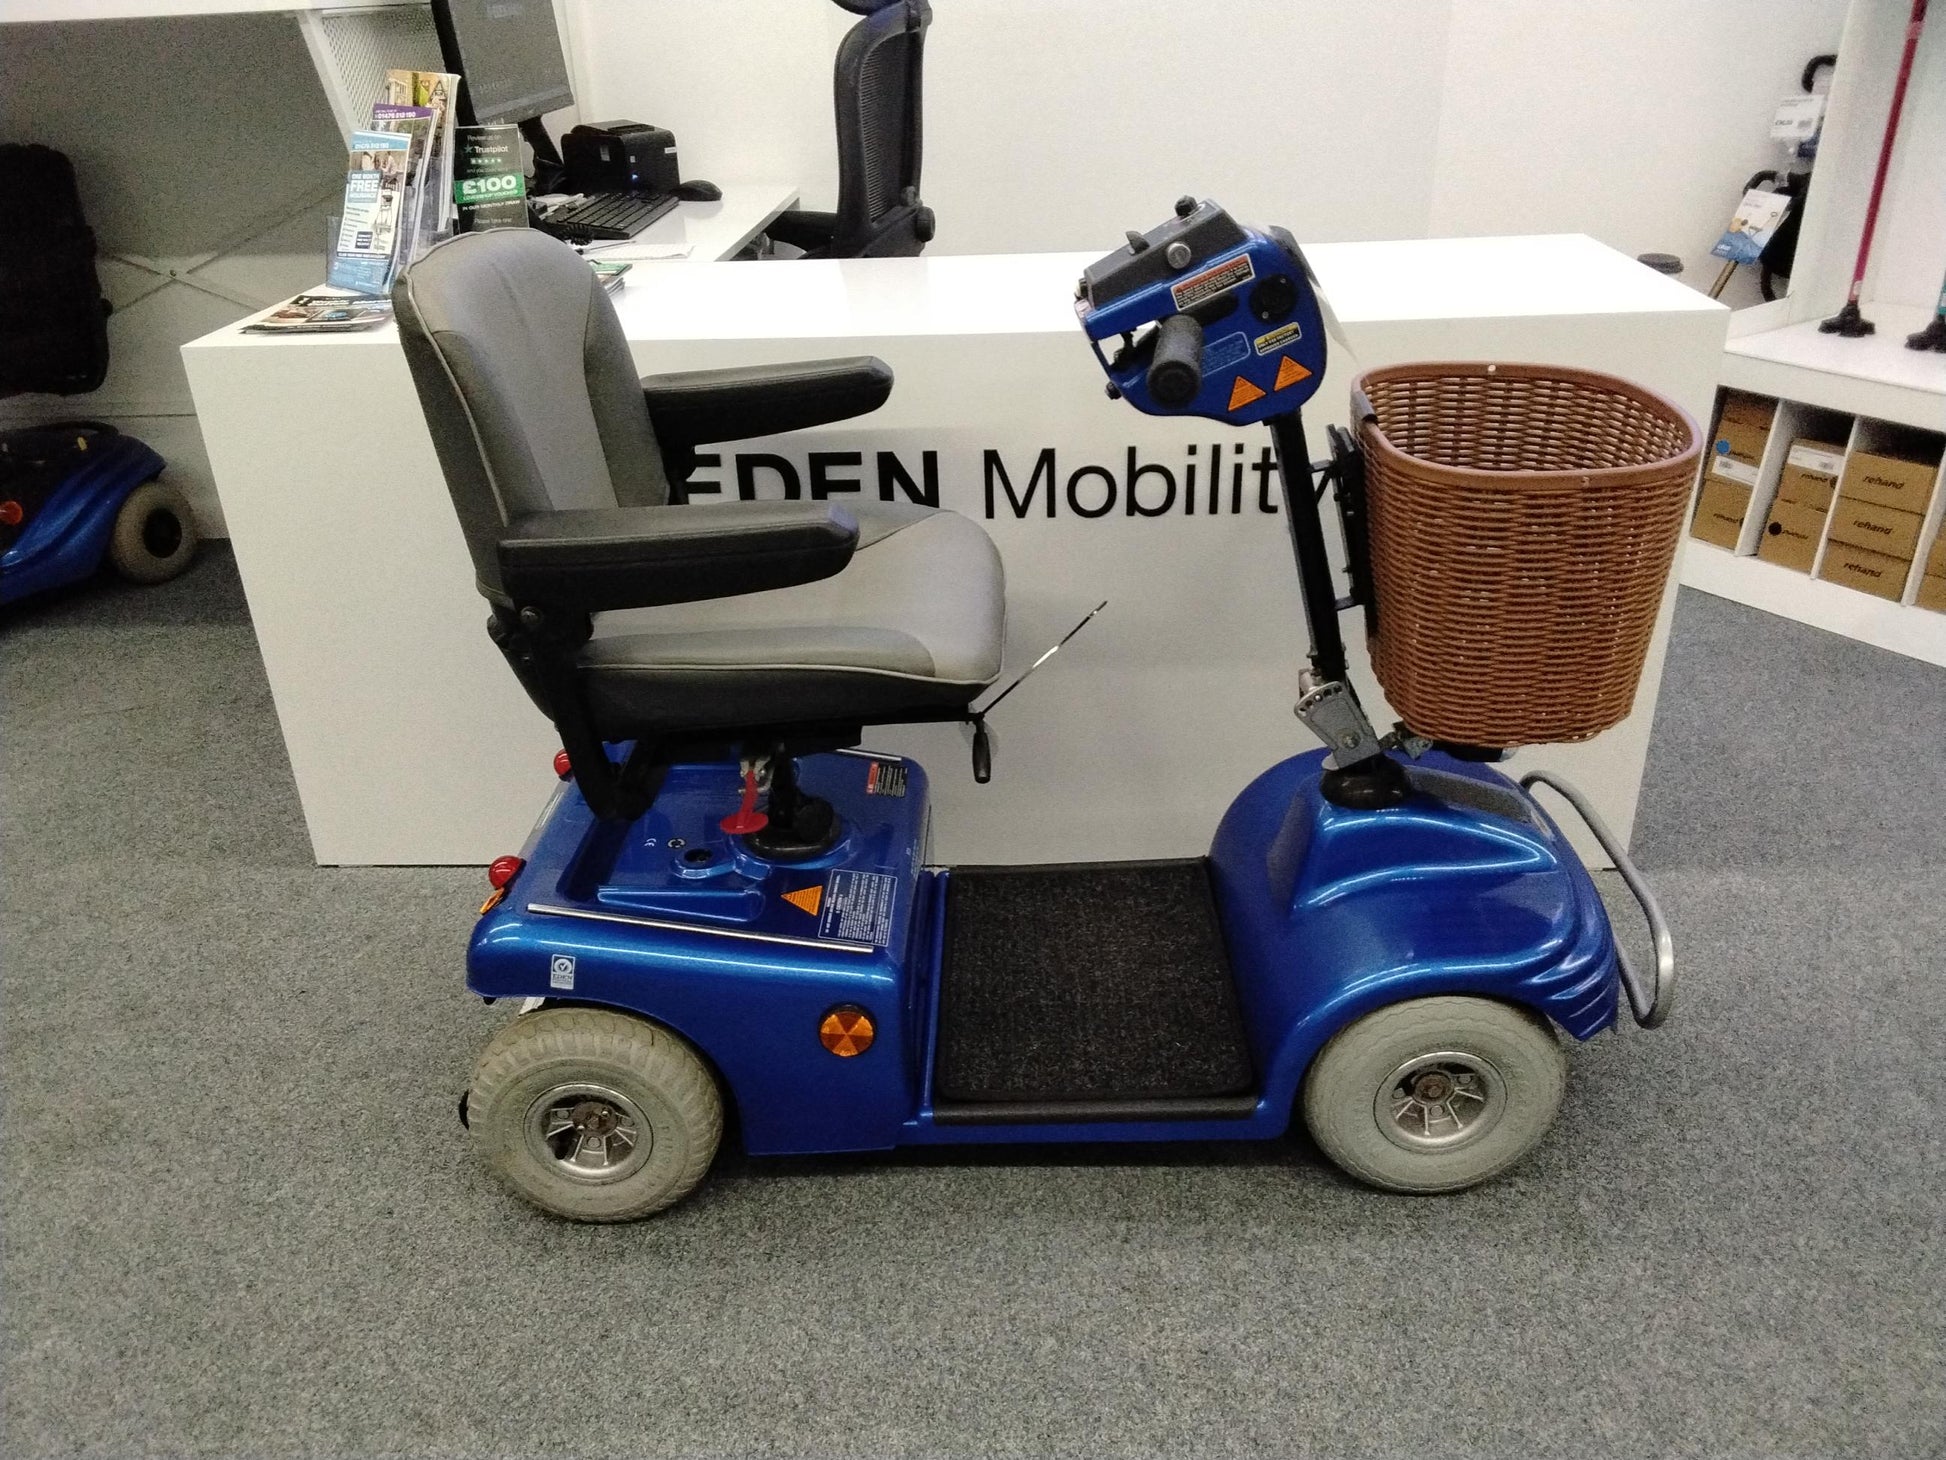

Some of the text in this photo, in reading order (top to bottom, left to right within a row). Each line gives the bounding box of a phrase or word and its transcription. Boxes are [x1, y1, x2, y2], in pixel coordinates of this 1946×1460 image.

[474, 145, 509, 154] Trustpilot
[350, 180, 379, 192] FREE
[462, 175, 517, 195] £100
